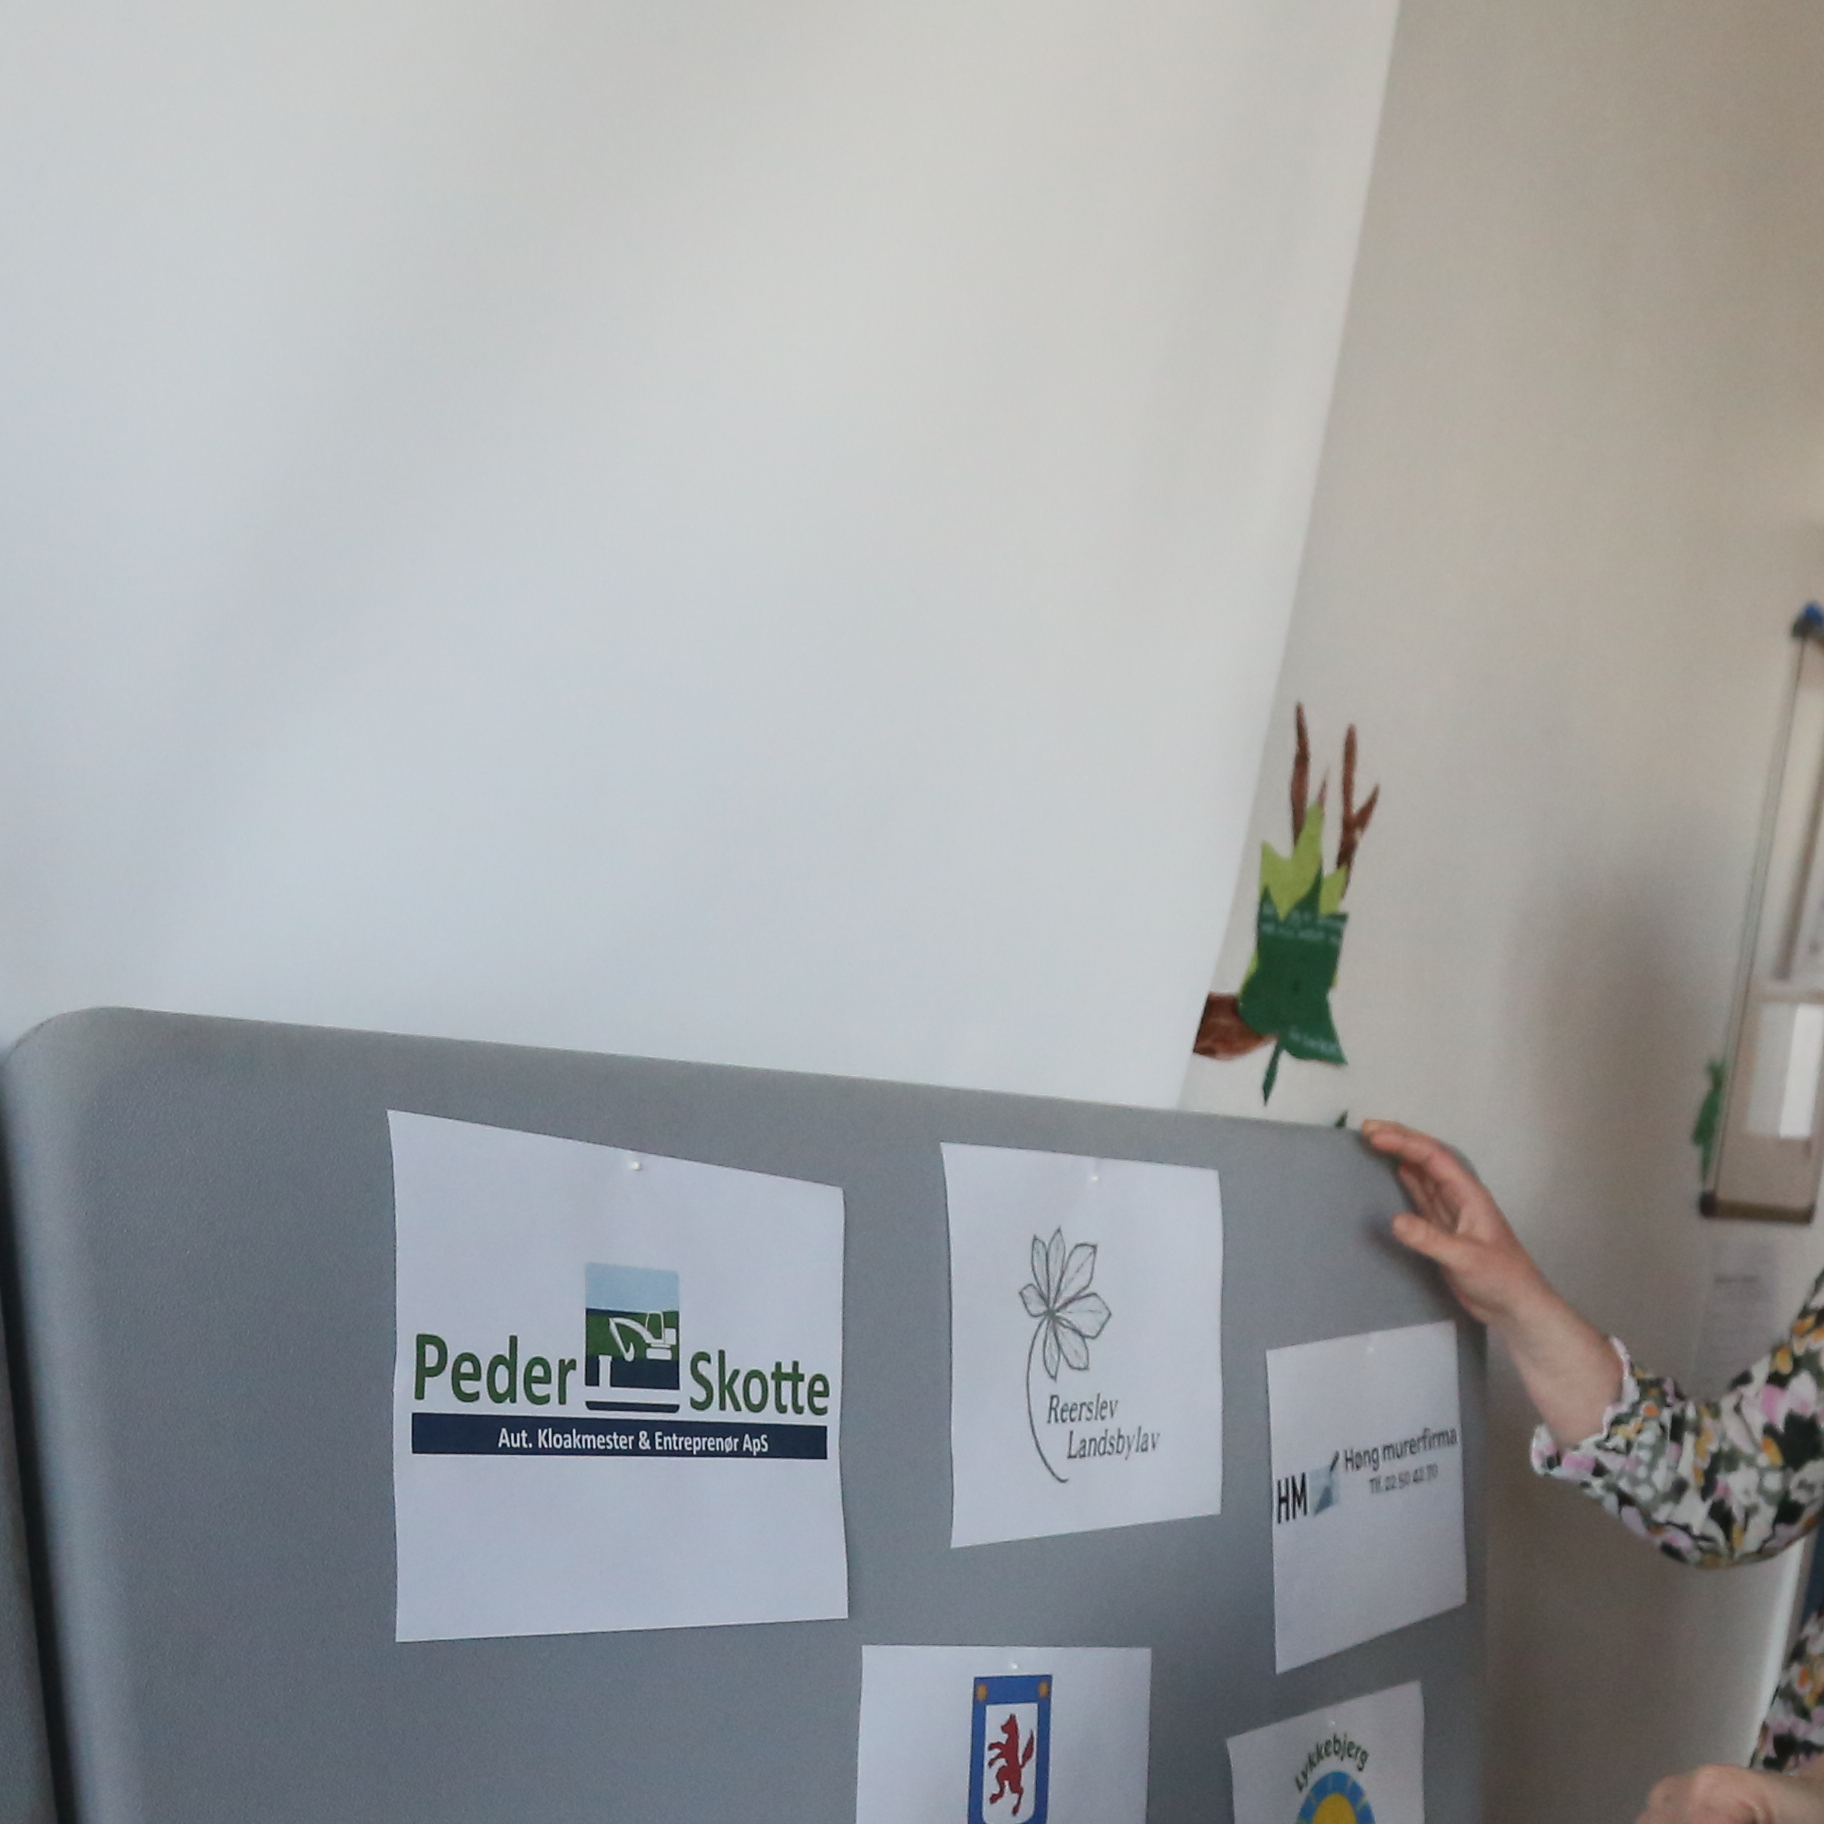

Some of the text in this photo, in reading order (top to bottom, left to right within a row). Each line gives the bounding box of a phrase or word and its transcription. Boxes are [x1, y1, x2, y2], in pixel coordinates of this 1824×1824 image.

[413, 1333, 831, 1417] Peder Skotte
[1046, 1393, 1120, 1425] Reerslev
[497, 1427, 770, 1456] Aut. Kloakmester & Entreprenør ApS
[1066, 1426, 1162, 1461] Landsbylav
[1343, 1427, 1458, 1472] Høng murerfirma
[1277, 1471, 1308, 1525] HM
[1294, 1732, 1369, 1794] Lykkebjerg
